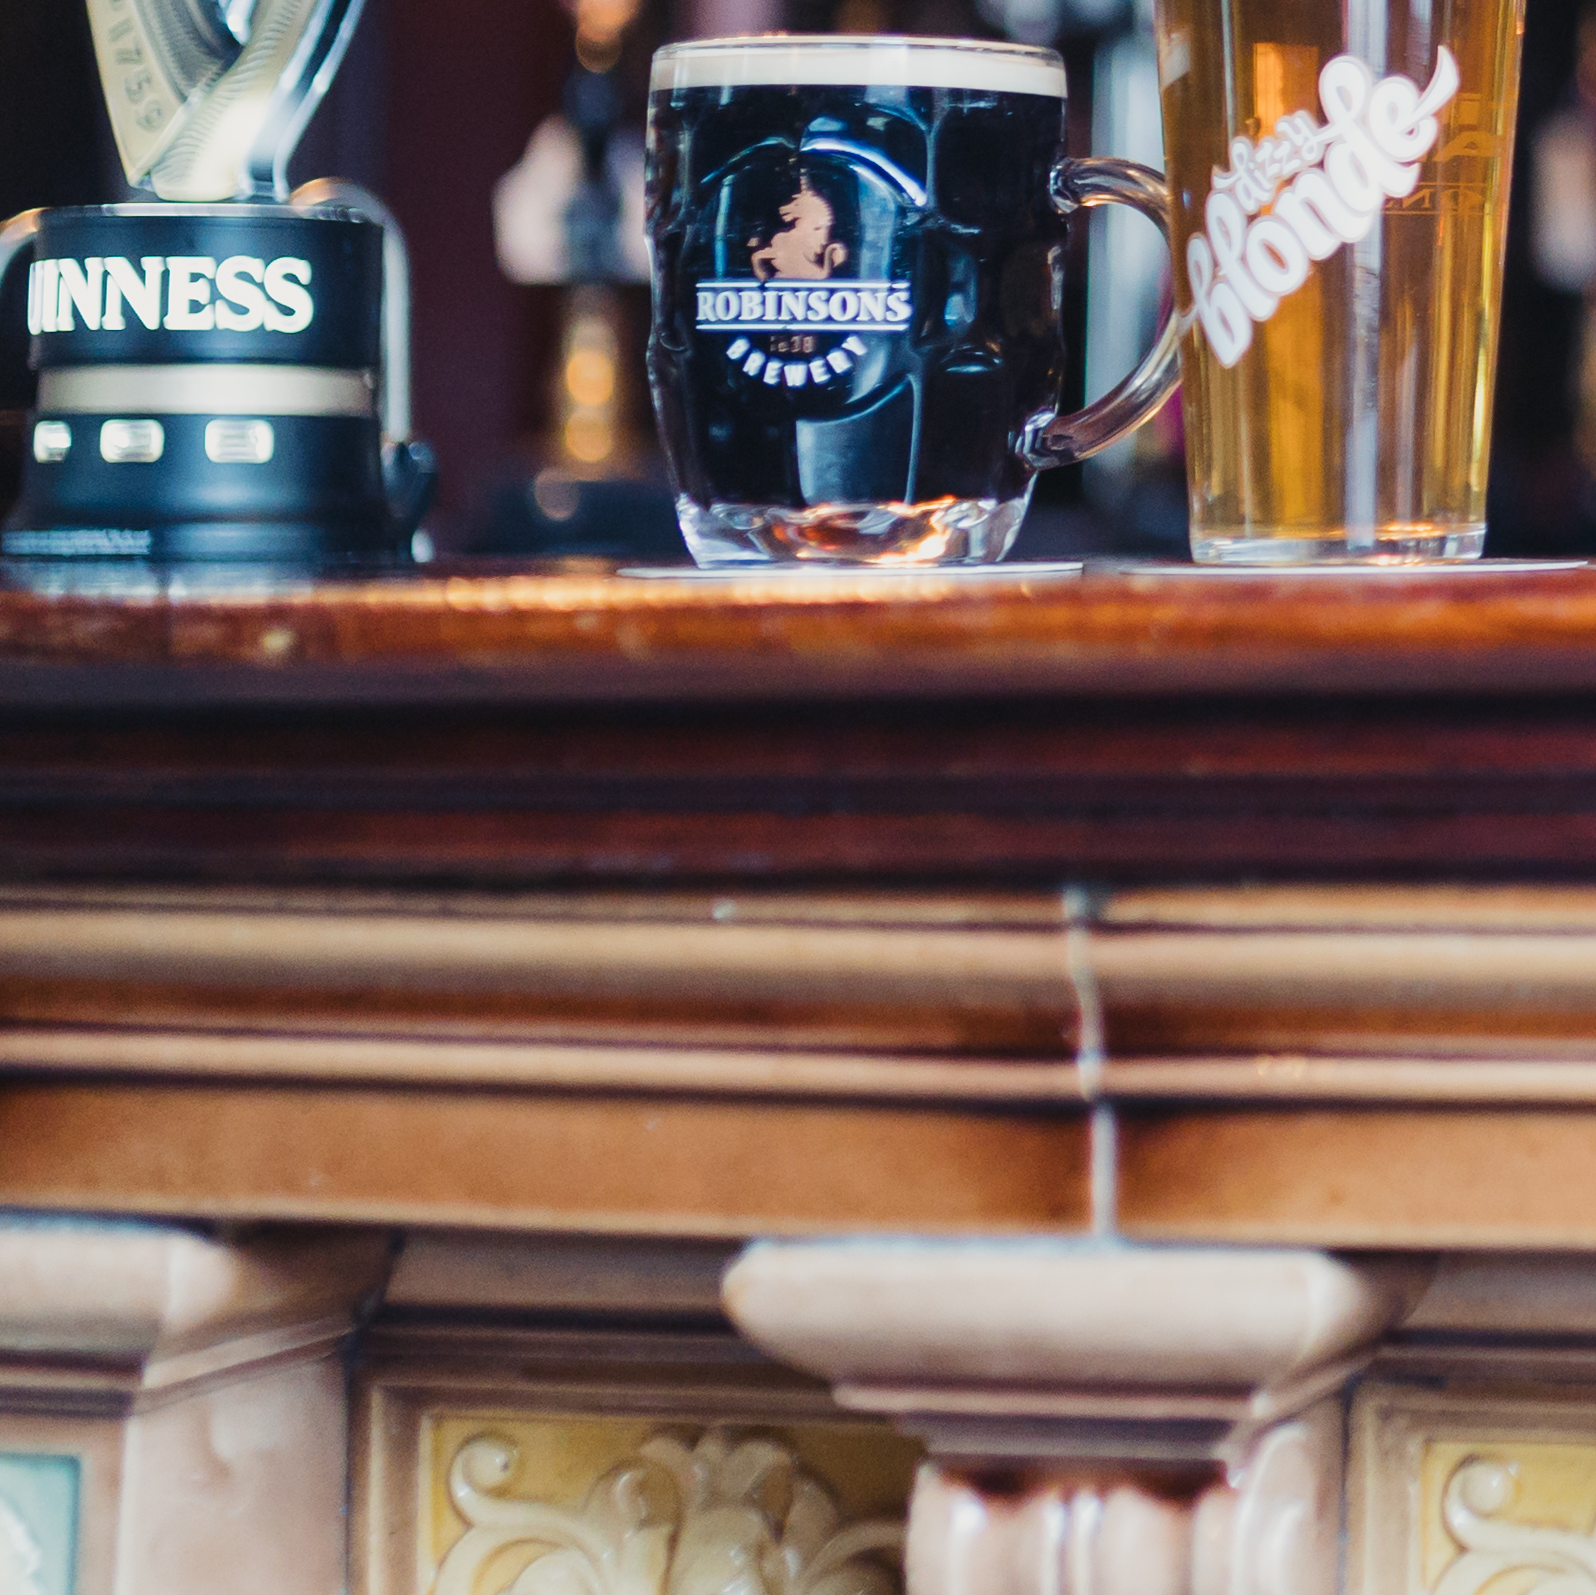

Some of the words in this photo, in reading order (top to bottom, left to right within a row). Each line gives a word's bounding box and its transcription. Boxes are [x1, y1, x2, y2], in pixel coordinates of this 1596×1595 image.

[1212, 111, 1332, 214] dizzy
[1180, 45, 1461, 368] blonde
[695, 290, 913, 322] ROBINSONS
[726, 335, 869, 389] BREWERY
